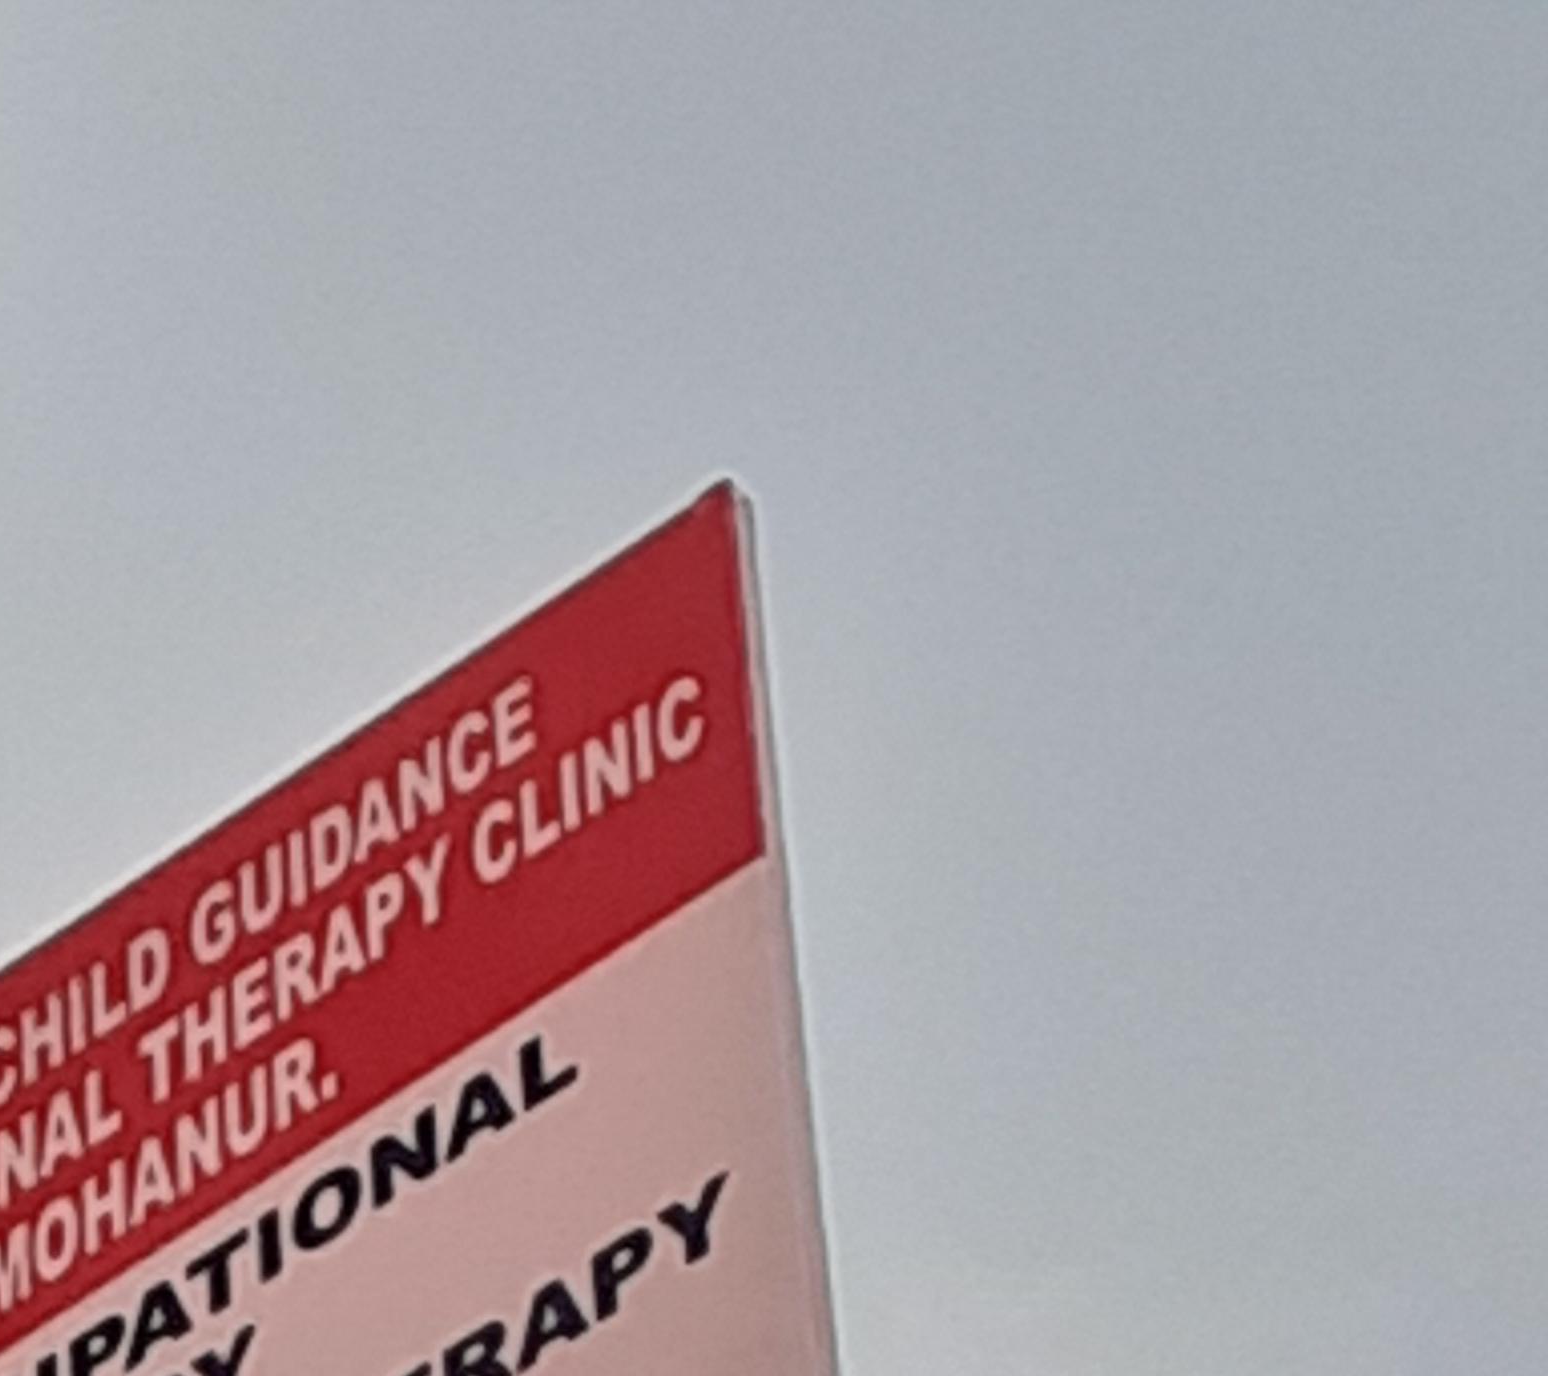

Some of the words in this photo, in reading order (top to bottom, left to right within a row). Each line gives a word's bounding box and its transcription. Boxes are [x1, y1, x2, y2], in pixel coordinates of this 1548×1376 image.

[138, 840, 451, 1104] THERAPY
[471, 677, 705, 884] CLINIC
[190, 676, 537, 966] GUIDANCE
